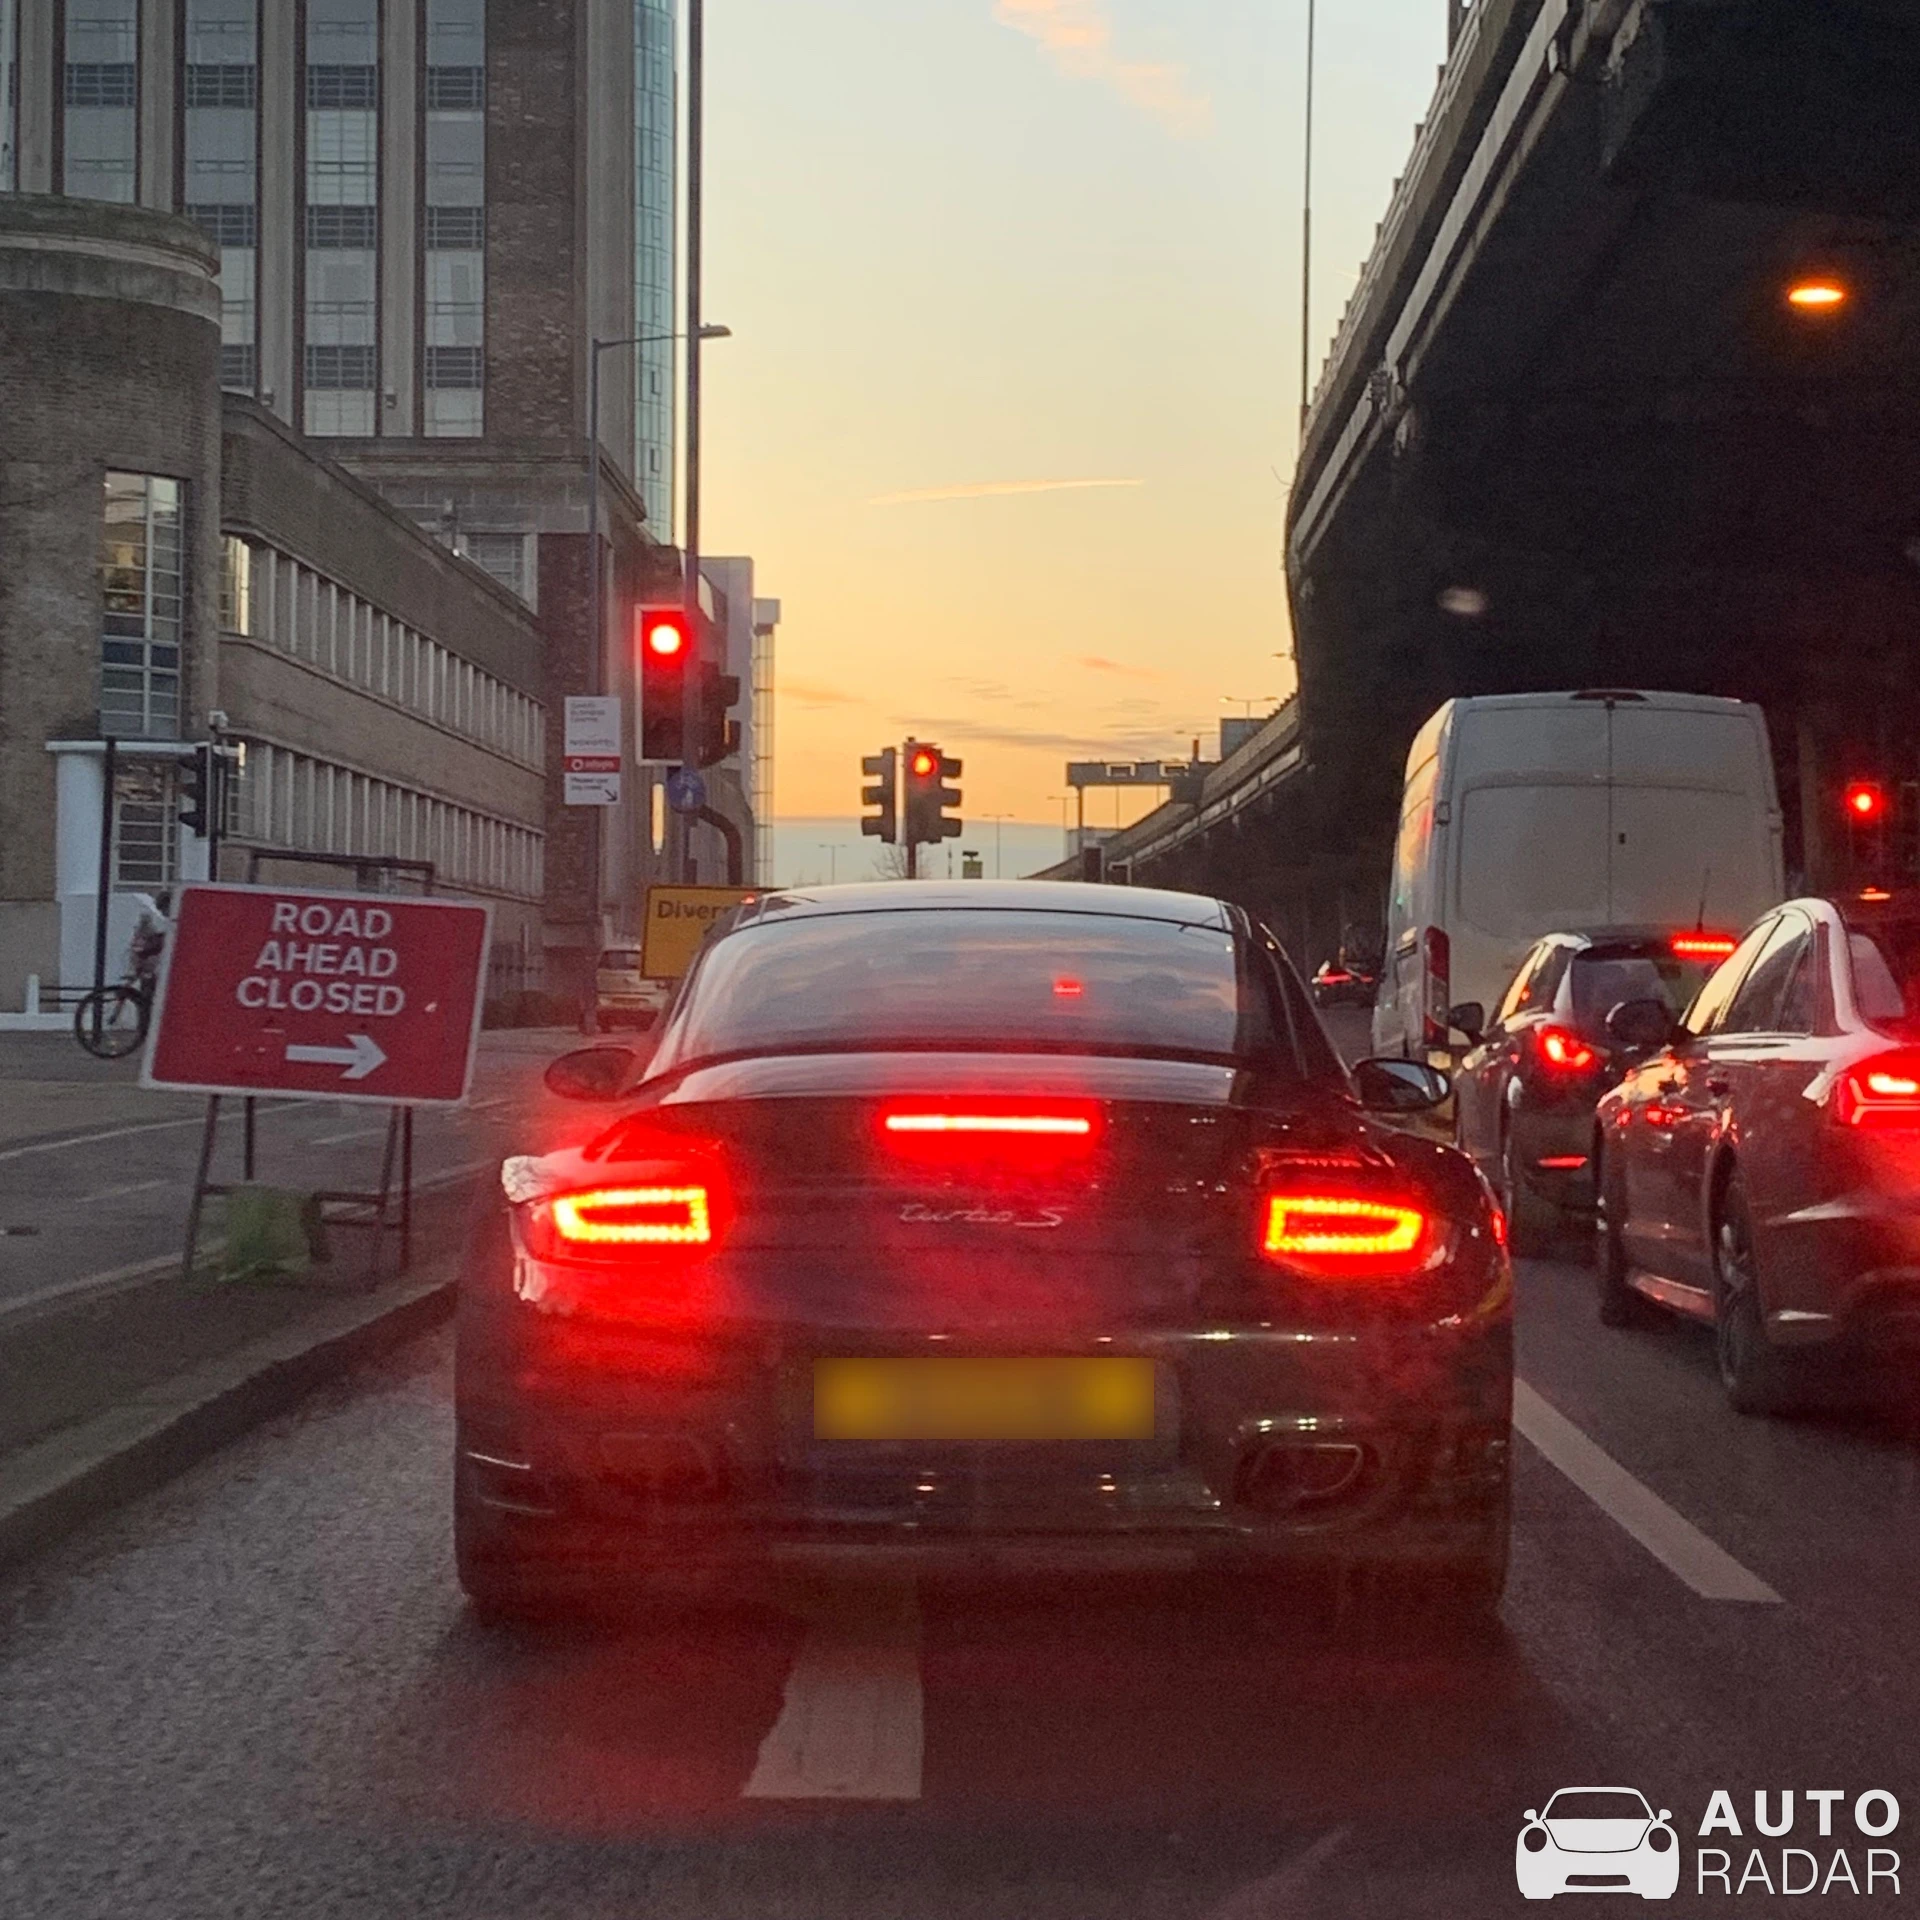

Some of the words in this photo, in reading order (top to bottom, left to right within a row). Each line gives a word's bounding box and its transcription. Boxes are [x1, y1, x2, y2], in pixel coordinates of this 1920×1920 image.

[271, 902, 393, 938] ROAD
[255, 940, 398, 977] AHEAD
[237, 976, 406, 1016] CLOSED
[1014, 1206, 1067, 1228] S
